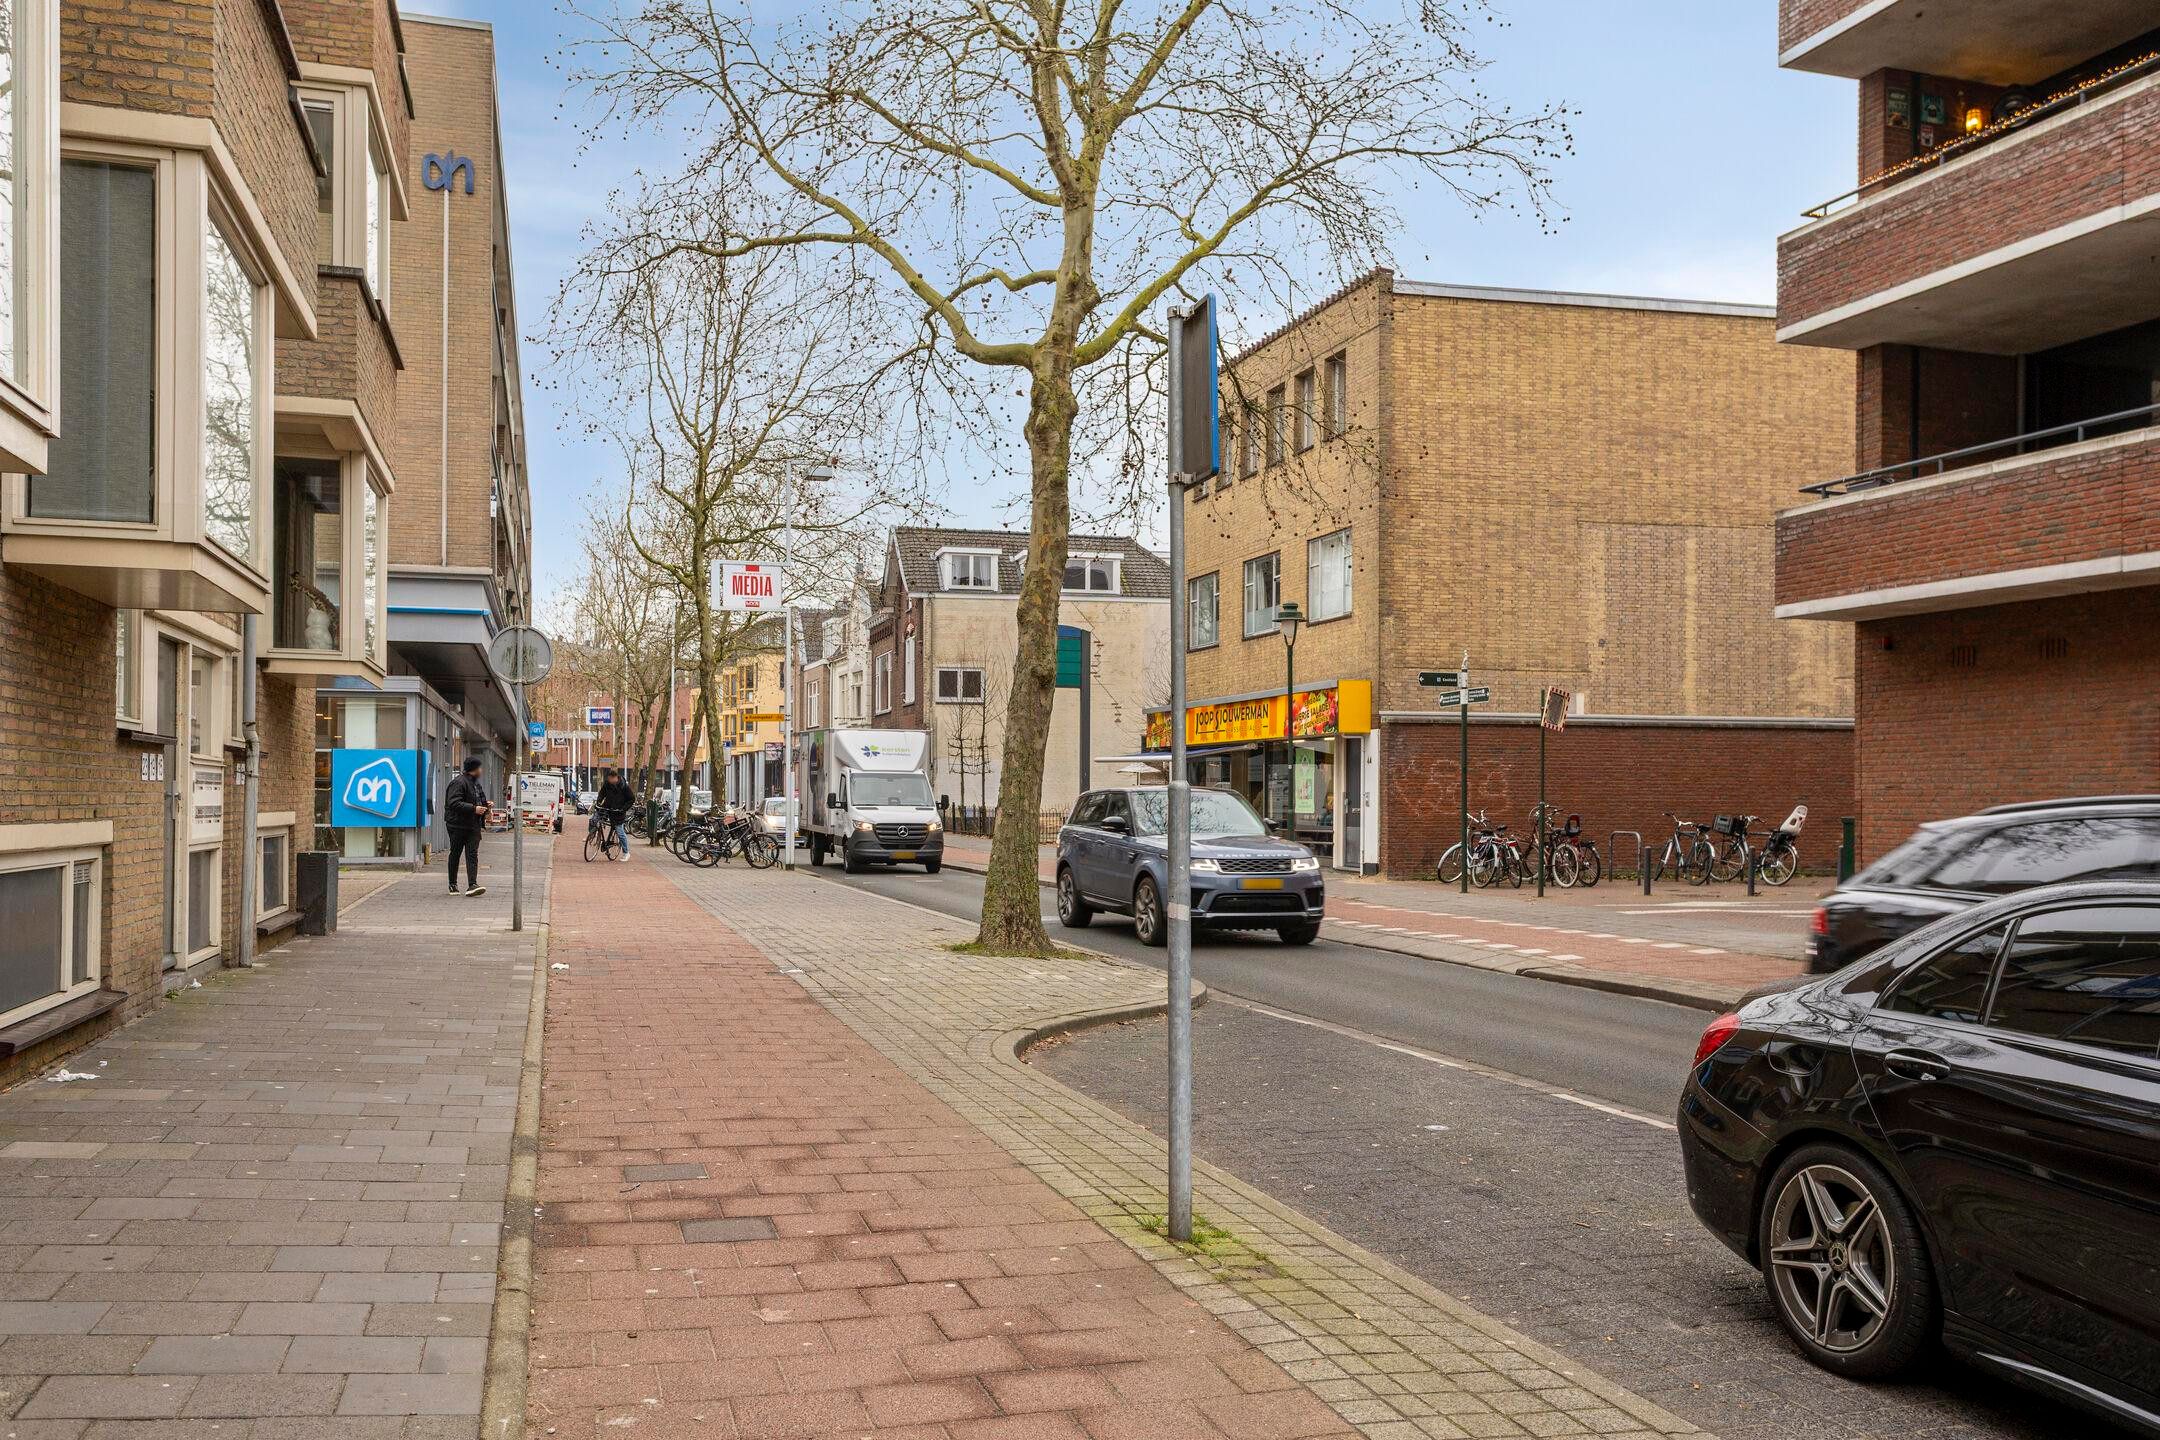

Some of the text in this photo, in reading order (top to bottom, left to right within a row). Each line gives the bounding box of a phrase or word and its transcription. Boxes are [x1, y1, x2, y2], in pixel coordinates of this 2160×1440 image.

[732, 575, 773, 596] MEDIA
[1195, 704, 1269, 735] JOOP SJOUWERMAN
[529, 781, 555, 789] TIELEMAN
